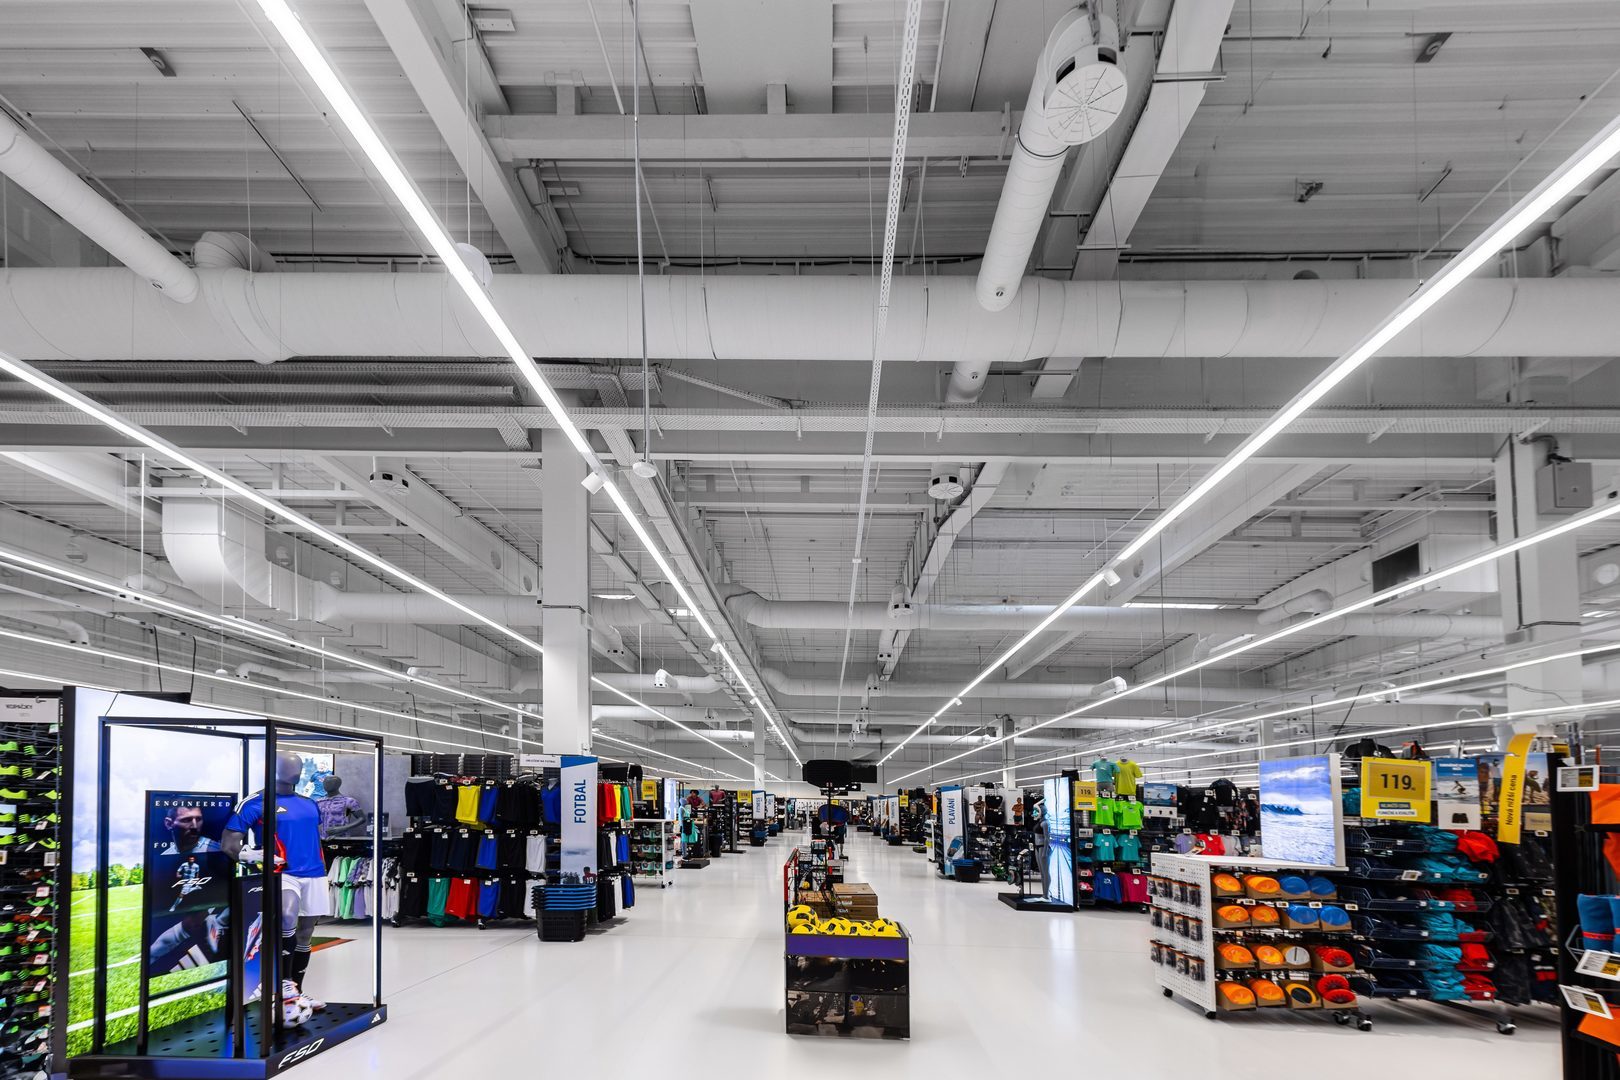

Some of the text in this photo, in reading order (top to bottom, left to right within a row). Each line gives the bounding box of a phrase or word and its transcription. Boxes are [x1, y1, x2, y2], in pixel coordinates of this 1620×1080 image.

[574, 779, 586, 823] FOTBAL
[947, 798, 955, 824] PLAVÁNÍ
[171, 876, 212, 888] F50
[278, 1038, 324, 1069] F50
